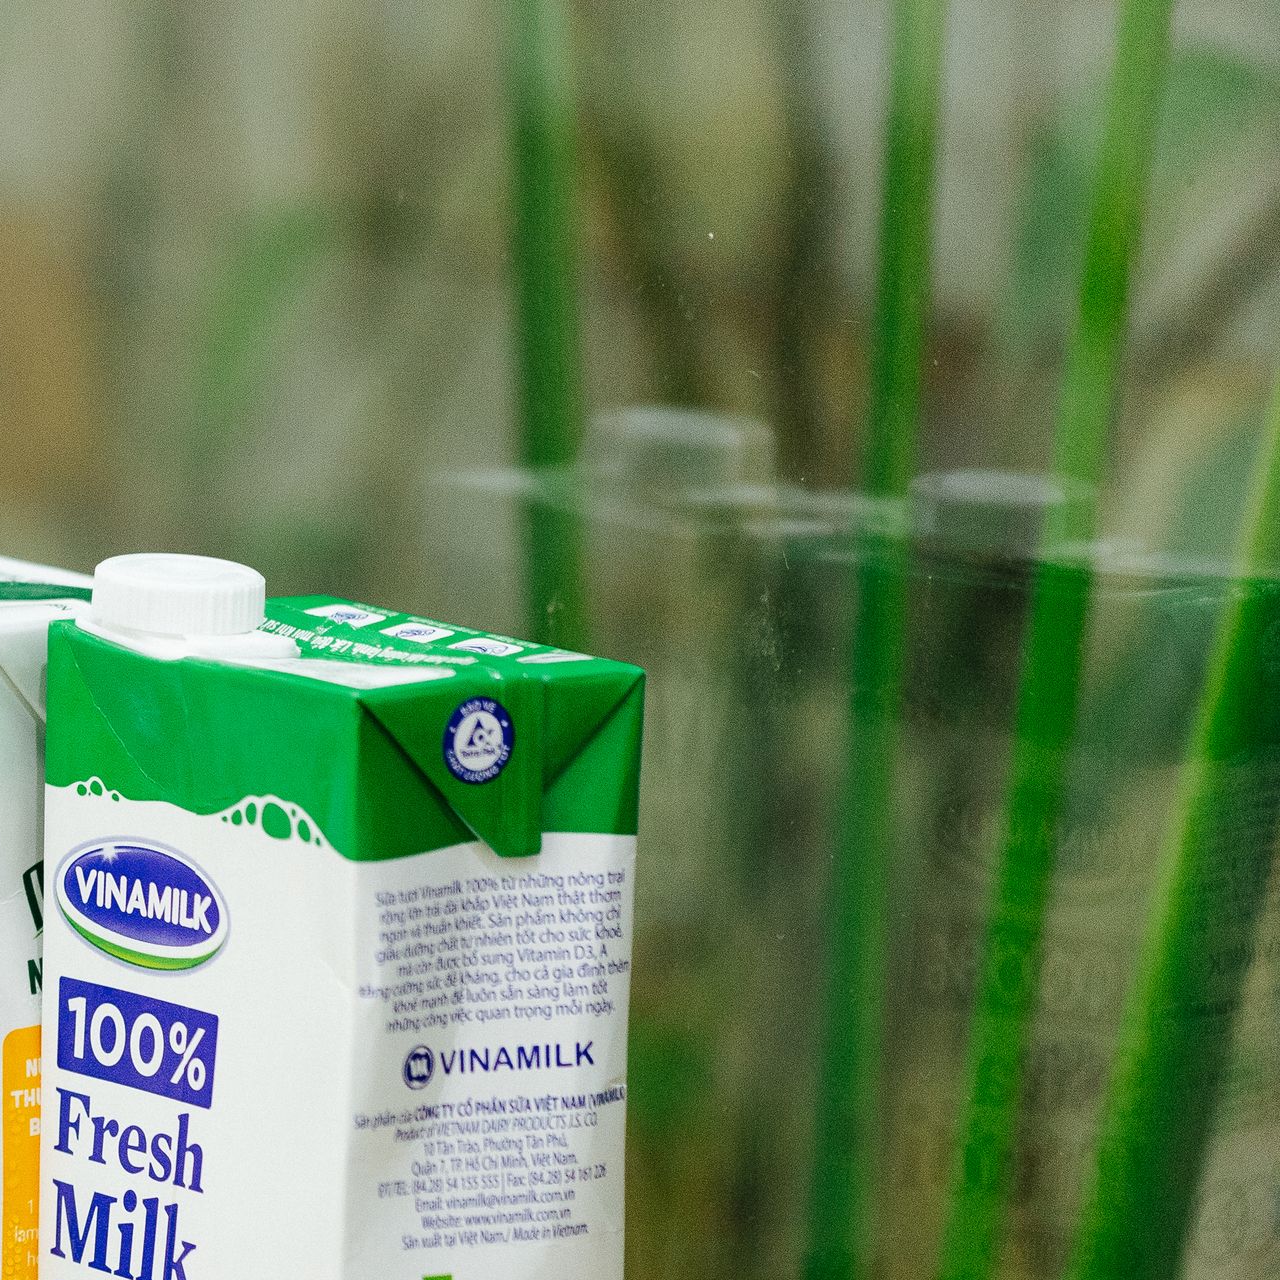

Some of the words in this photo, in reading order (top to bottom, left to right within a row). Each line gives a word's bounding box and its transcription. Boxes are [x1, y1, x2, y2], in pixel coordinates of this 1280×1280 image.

[420, 880, 461, 899] Vinamilk
[466, 877, 499, 892] 100%
[520, 872, 564, 891] những
[567, 872, 604, 888] nông
[75, 865, 212, 934] VINAMILK
[491, 894, 518, 910] Việt
[522, 893, 554, 907] Nam
[558, 890, 585, 907] thật
[488, 913, 513, 929] Sản
[515, 909, 556, 929] phẩm
[560, 908, 603, 924] không
[474, 932, 513, 947] nhiên
[516, 929, 535, 944] tốt
[539, 928, 565, 944] cho
[568, 927, 592, 941] sức
[480, 953, 514, 968] sung
[517, 947, 571, 962] Vitamin
[574, 945, 597, 960] D3,
[600, 943, 609, 958] A
[505, 967, 531, 981] cho
[533, 964, 549, 981] cả
[553, 965, 574, 983] gia
[465, 988, 497, 1002] luôn
[527, 984, 560, 1002] sàng
[563, 982, 589, 998] làm
[475, 1008, 511, 1023] quan
[514, 1005, 553, 1021] trọng
[67, 995, 207, 1091] 100%
[440, 1041, 595, 1076] VINAMILK
[441, 1102, 456, 1118] TY
[457, 1097, 473, 1117] CỔ
[533, 1094, 559, 1112] VIỆT
[561, 1095, 586, 1109] NAM
[433, 1119, 480, 1137] VIETNAM
[513, 1113, 566, 1132] PRODUCTS
[53, 1087, 205, 1194] Fresh
[459, 1230, 478, 1247] Việt
[512, 1226, 540, 1241] Made
[542, 1226, 551, 1239] in
